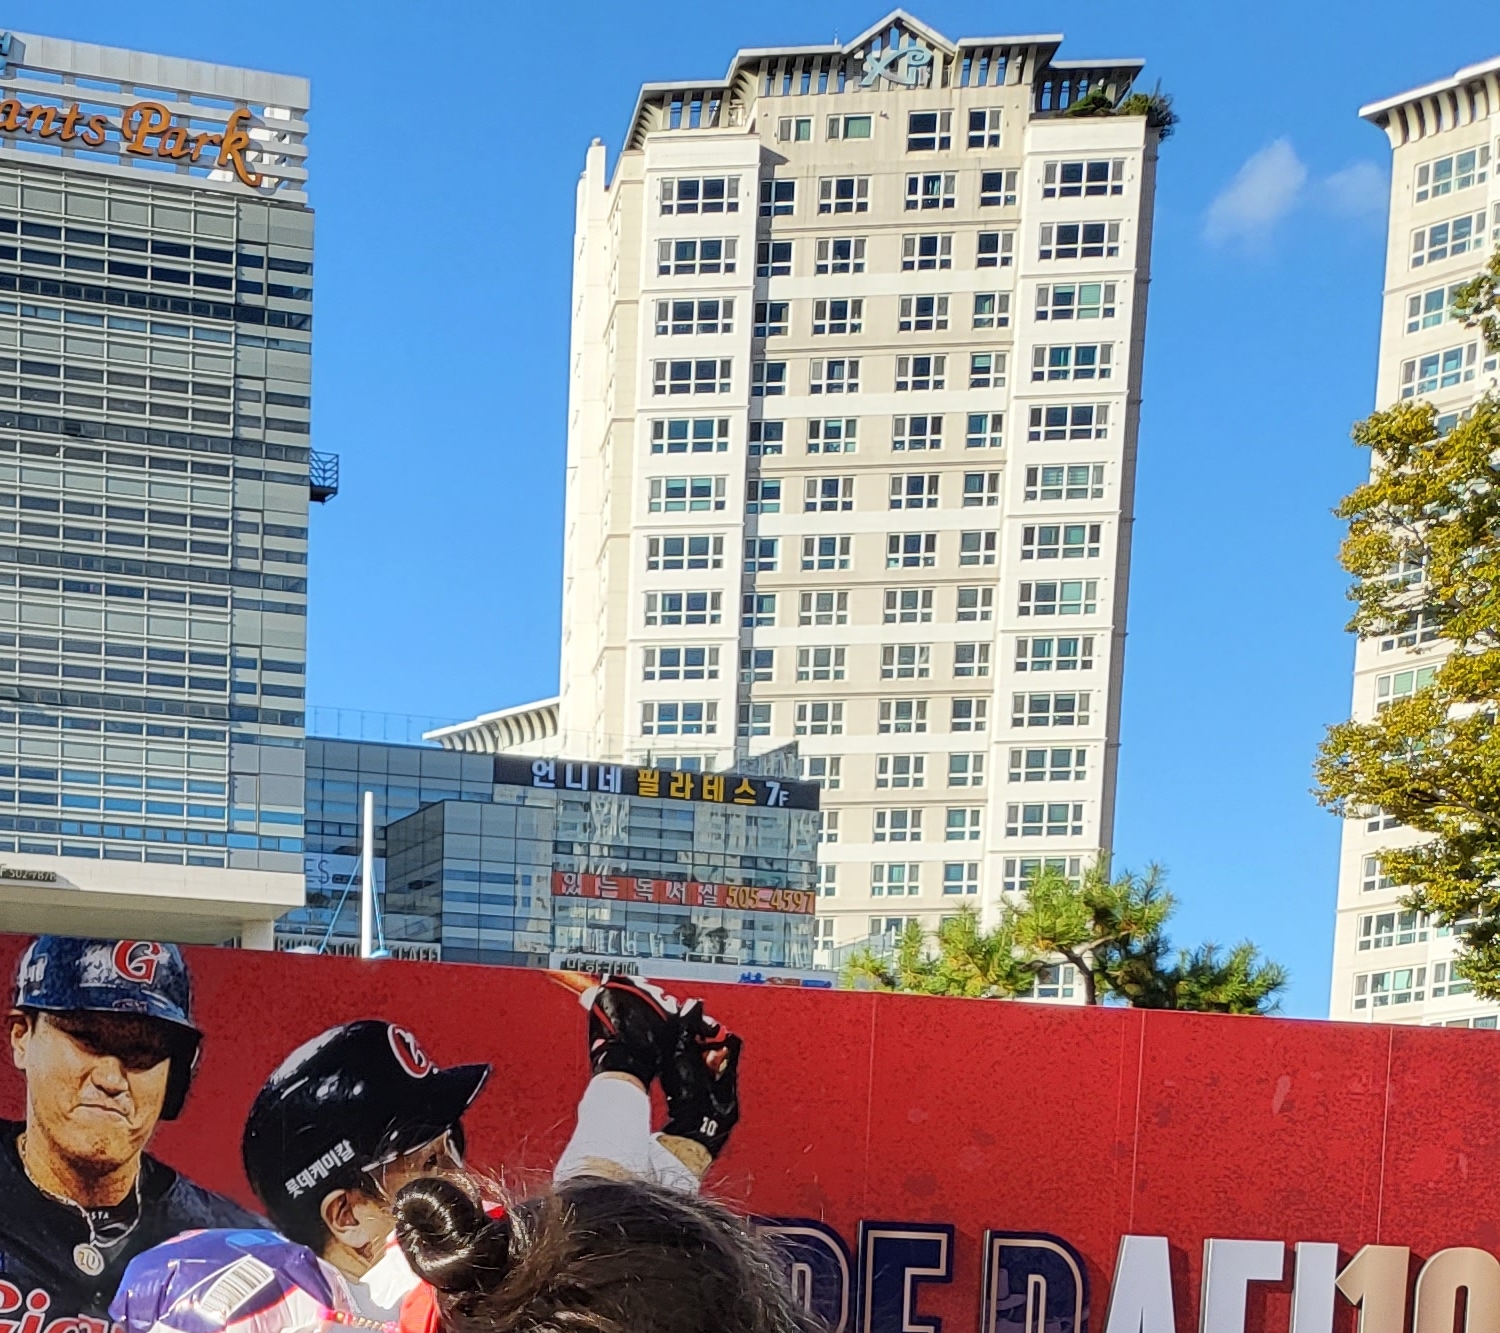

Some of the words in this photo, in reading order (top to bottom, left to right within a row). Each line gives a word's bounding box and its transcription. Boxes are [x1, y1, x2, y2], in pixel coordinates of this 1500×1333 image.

[122, 101, 263, 187] Park
[531, 759, 623, 794] 언니네
[637, 768, 757, 806] 필라테스
[765, 781, 790, 807] 7F
[561, 873, 619, 899] 있는
[632, 879, 720, 907] 독서실
[725, 886, 815, 914] 505-4597
[284, 1138, 356, 1199] 롯데케미칼
